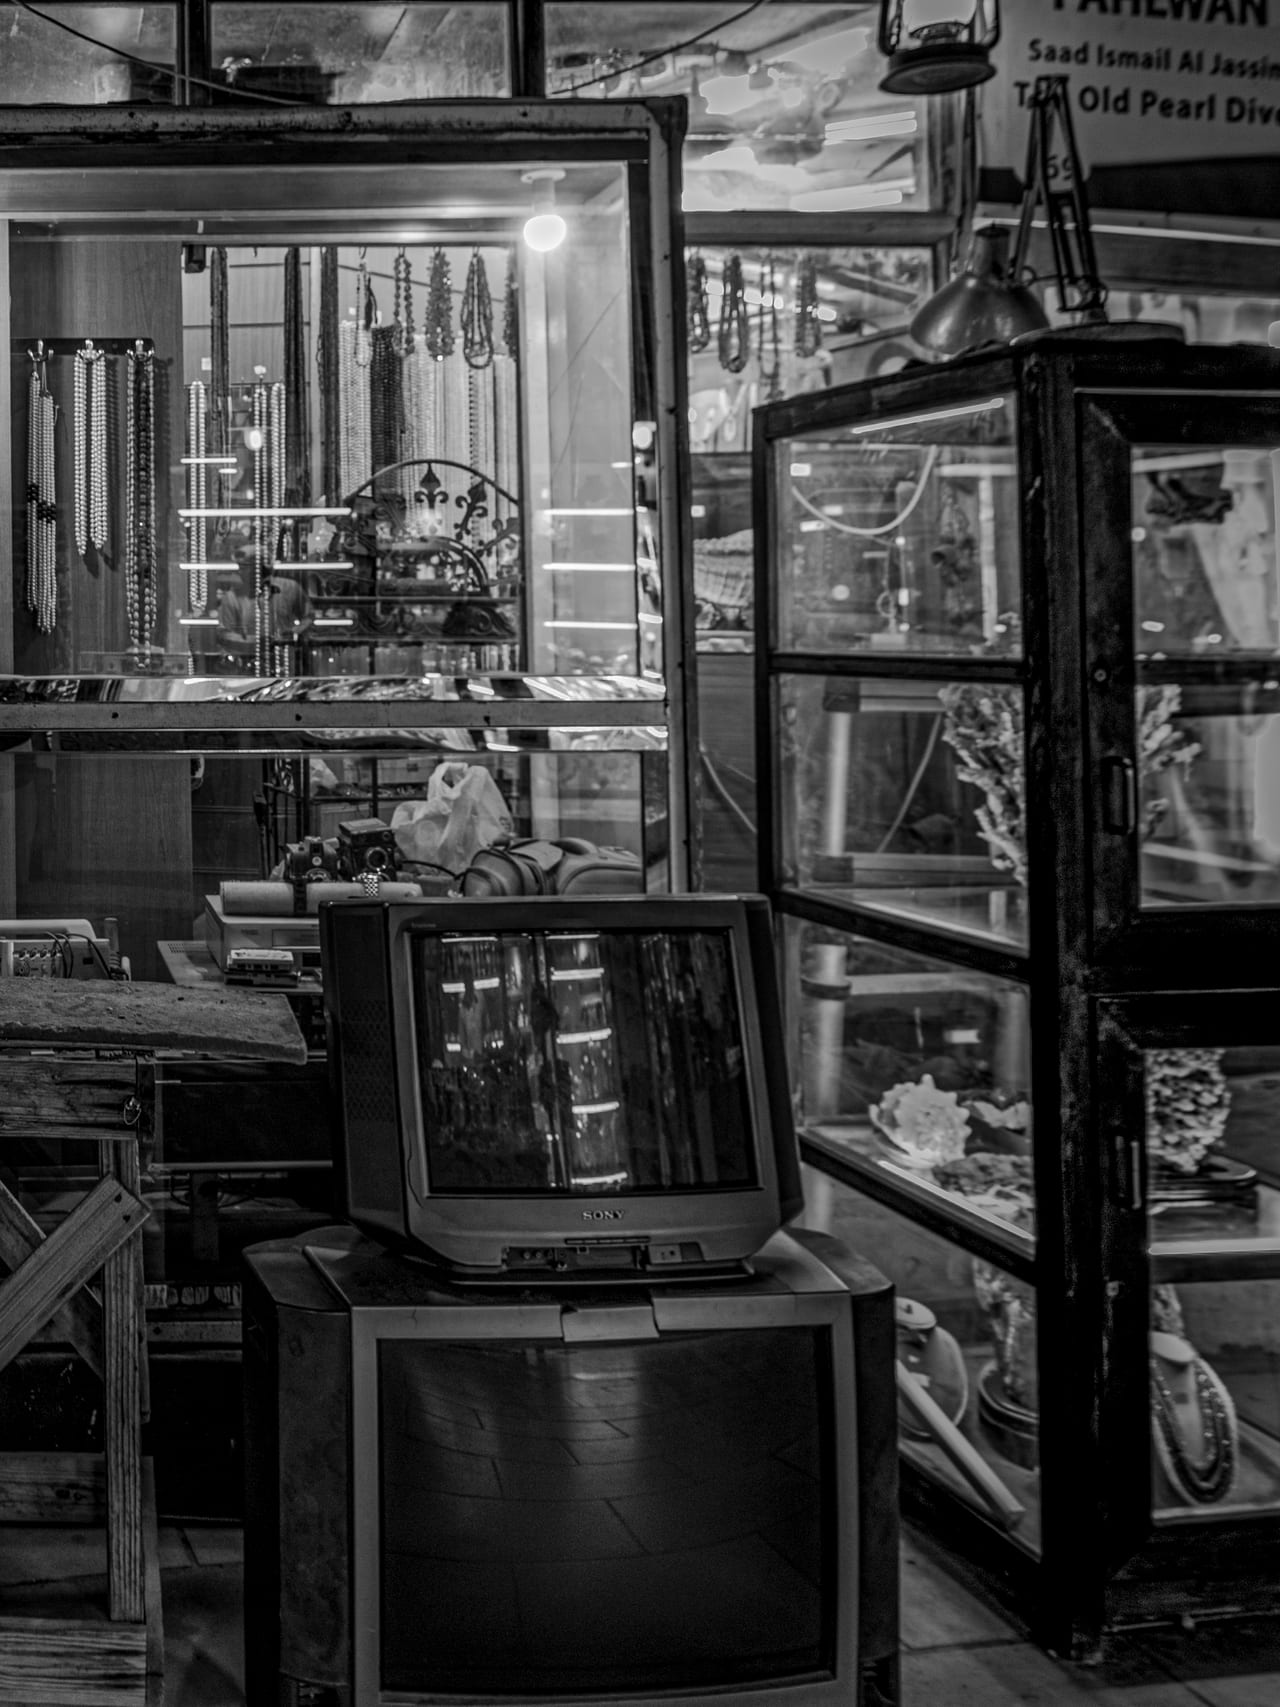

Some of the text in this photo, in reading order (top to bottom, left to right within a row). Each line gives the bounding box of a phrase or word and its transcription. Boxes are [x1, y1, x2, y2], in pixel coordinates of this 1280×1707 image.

[1028, 38, 1089, 65] Saad
[1097, 44, 1171, 72] Ismail
[1178, 50, 1203, 75] Al
[1079, 85, 1130, 114] Old
[1141, 90, 1216, 121] Pearl
[1226, 96, 1280, 126] Div
[583, 1209, 624, 1221] SONY
